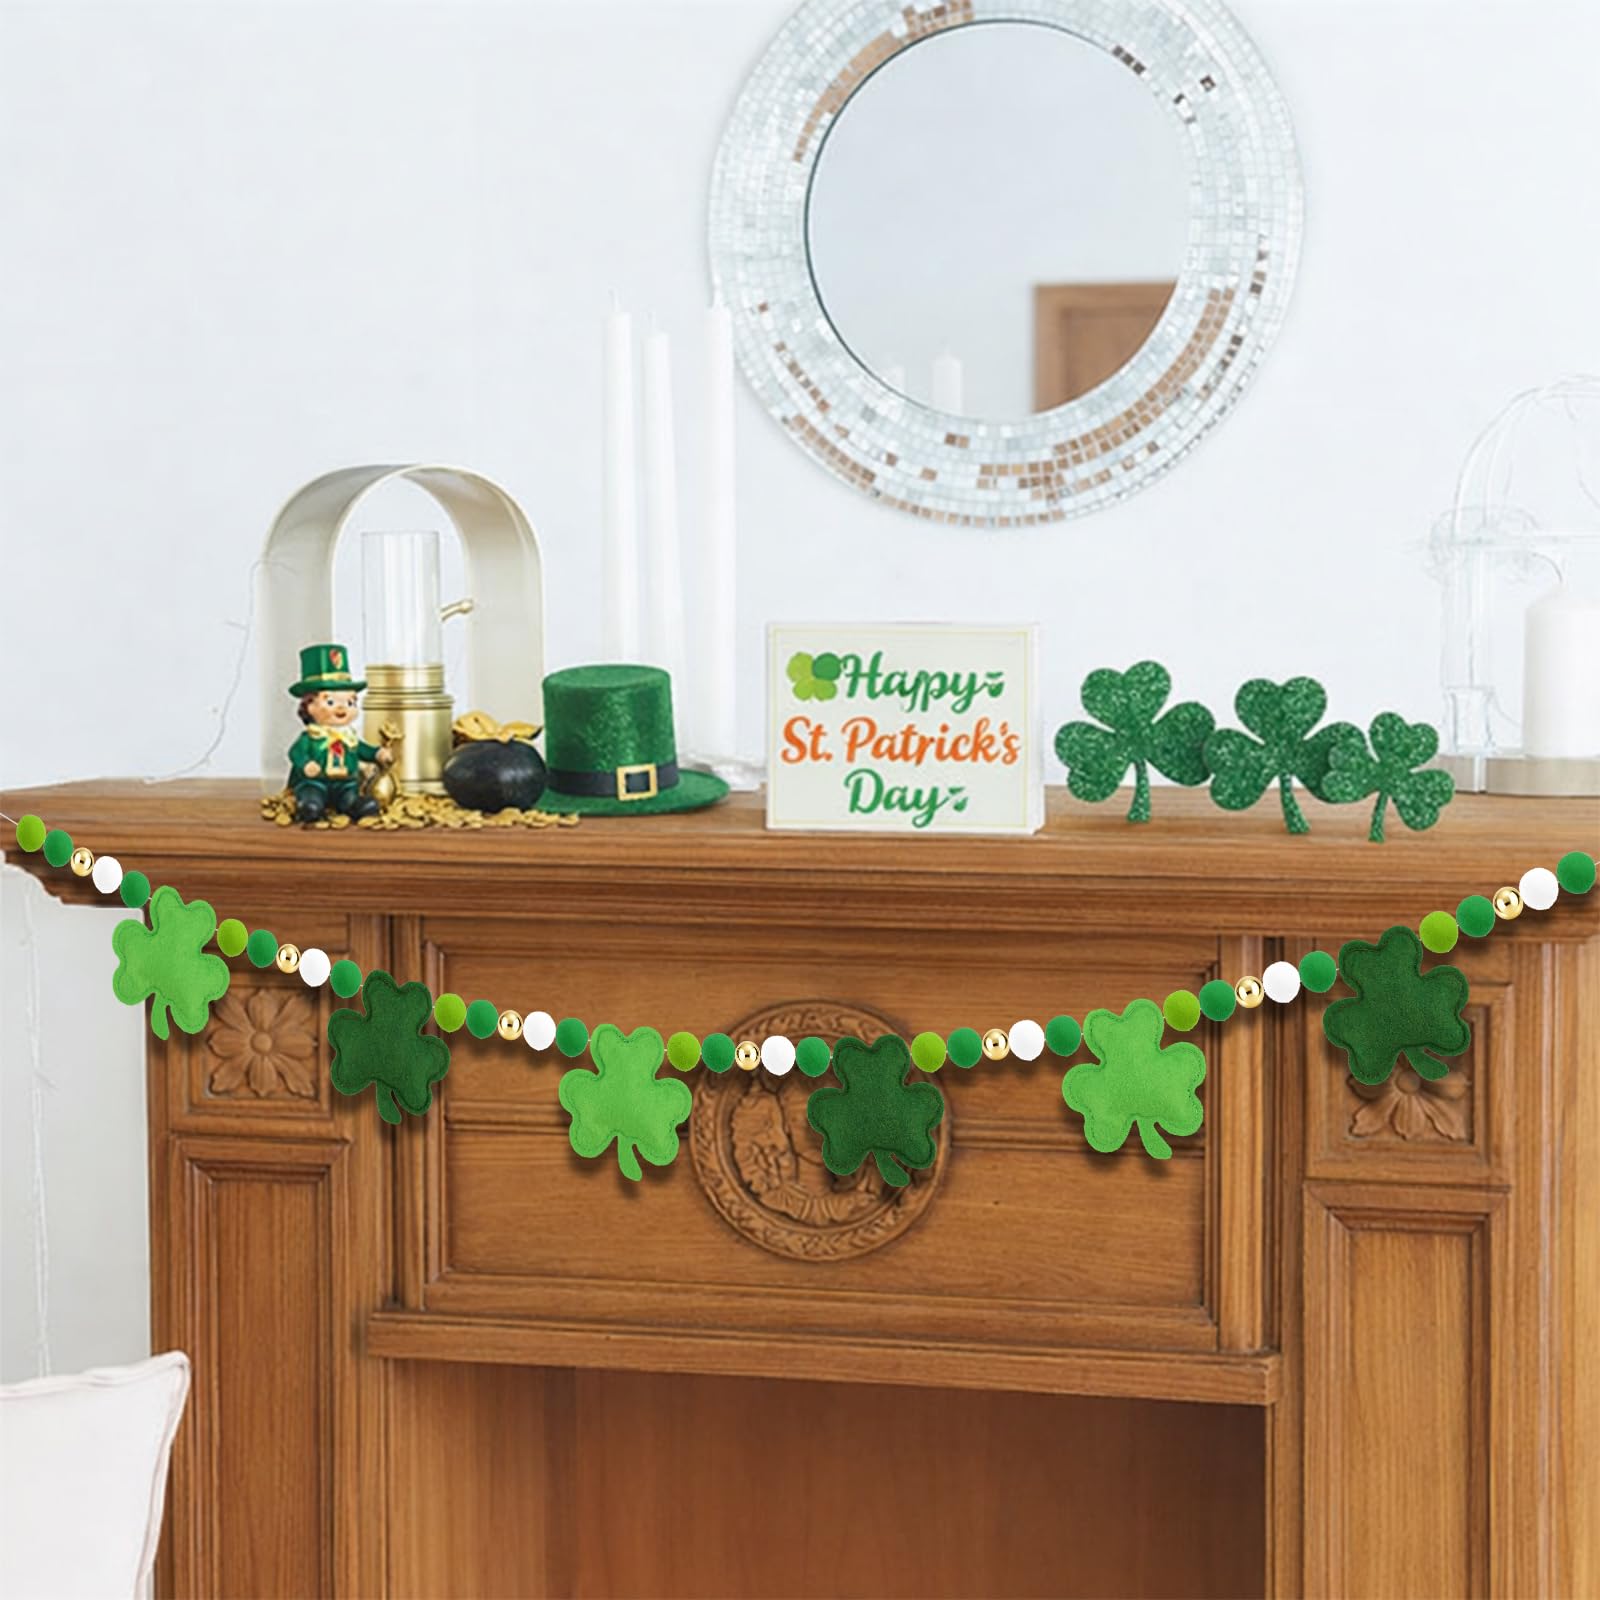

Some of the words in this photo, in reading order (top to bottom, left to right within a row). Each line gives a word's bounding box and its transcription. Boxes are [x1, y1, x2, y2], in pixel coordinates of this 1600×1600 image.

[841, 651, 985, 714] Happy
[781, 716, 833, 763] St.
[841, 717, 1020, 766] Patrick's
[844, 768, 948, 828] Day
